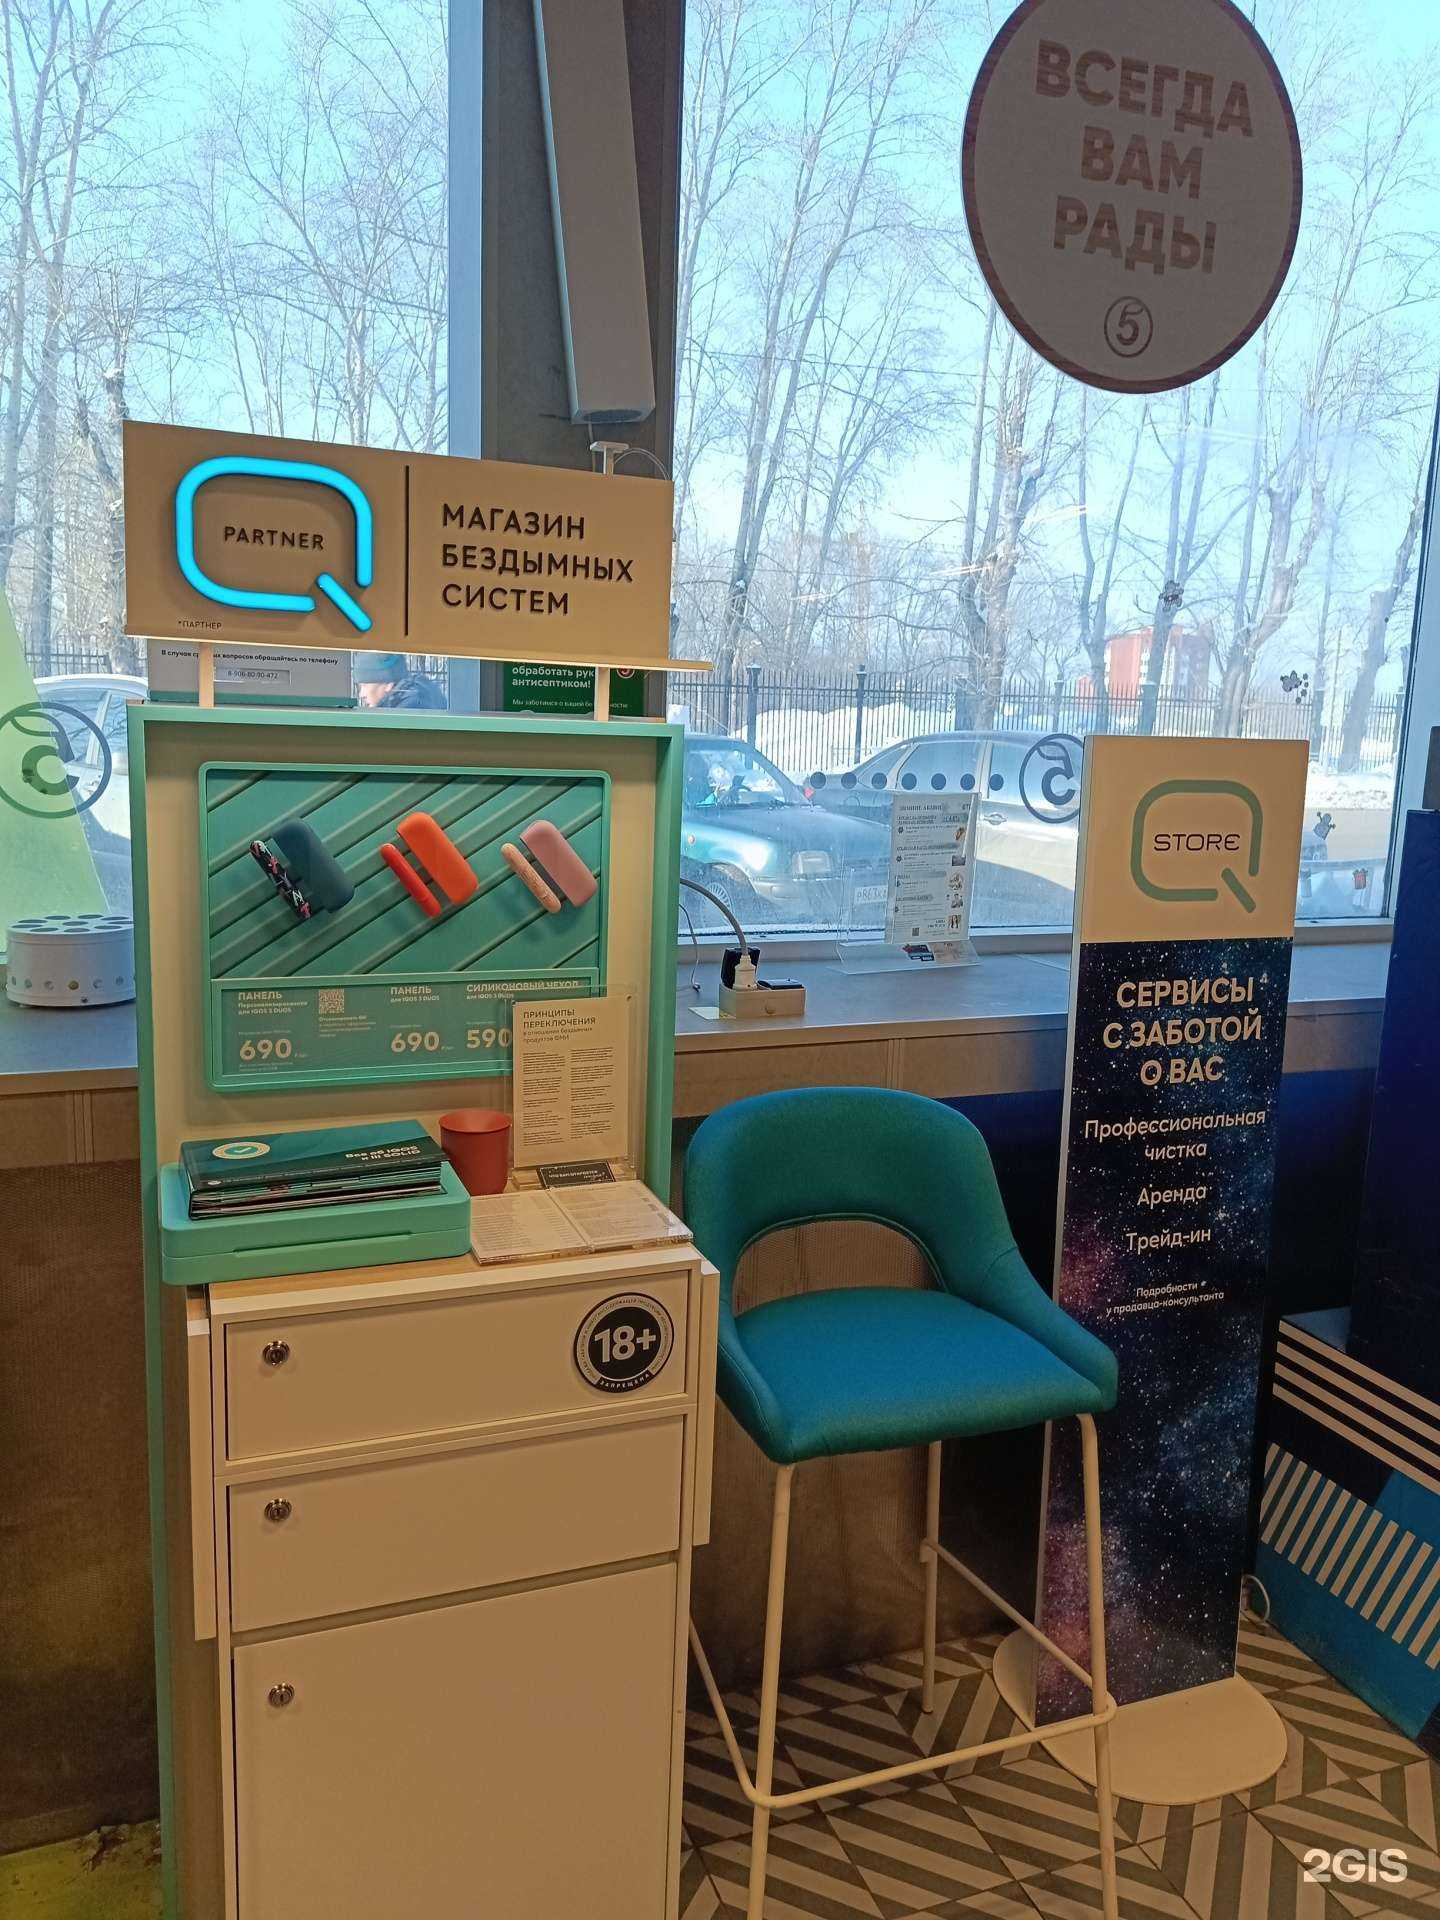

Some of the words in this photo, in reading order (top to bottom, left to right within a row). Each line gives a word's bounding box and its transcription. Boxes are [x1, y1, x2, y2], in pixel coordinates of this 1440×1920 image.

[1034, 38, 1254, 138] ВСЕГДА
[1080, 125, 1204, 200] ВАМ
[1053, 195, 1217, 275] РАДЫ
[442, 503, 585, 540] МАГАЗИН
[223, 526, 324, 550] PARTNER
[441, 543, 634, 583] БЕЗДЫМНЫХ
[441, 583, 569, 616] СИСТЕМ
[254, 654, 299, 664] обращайтесь
[308, 656, 339, 666] телефону
[511, 665, 574, 678] обработать
[511, 678, 592, 689] антисептиком!
[1152, 832, 1242, 853] STORE
[238, 991, 282, 1001] ПАНЕЛЬ
[390, 985, 432, 995] ПАНЕЛЬ
[466, 980, 545, 992] СИЛИКОНОВЫЙ
[1116, 976, 1254, 1008] СЕРВИСЫ
[523, 1008, 575, 1019] ПРИНЦИПЫ
[523, 1017, 596, 1029] ПЕРЕКЛЮЧЕНИЯ
[466, 1028, 512, 1049] 590
[1102, 1022, 1124, 1049] С
[1129, 1007, 1262, 1047] ЗАБОТОЙ
[240, 1038, 292, 1061] 690
[390, 1031, 440, 1052] 690
[1140, 1059, 1162, 1086] О
[1169, 1055, 1224, 1084] ВАС
[1084, 1110, 1267, 1143] Профессиональная
[1144, 1142, 1208, 1161] чистка
[1137, 1185, 1207, 1209] Аренда
[1125, 1228, 1212, 1255] Трейд-ин
[1136, 1282, 1198, 1299] Подробности
[1105, 1306, 1111, 1317] у
[1113, 1291, 1225, 1315] продавца-консультанта
[594, 1325, 657, 1363] 18+
